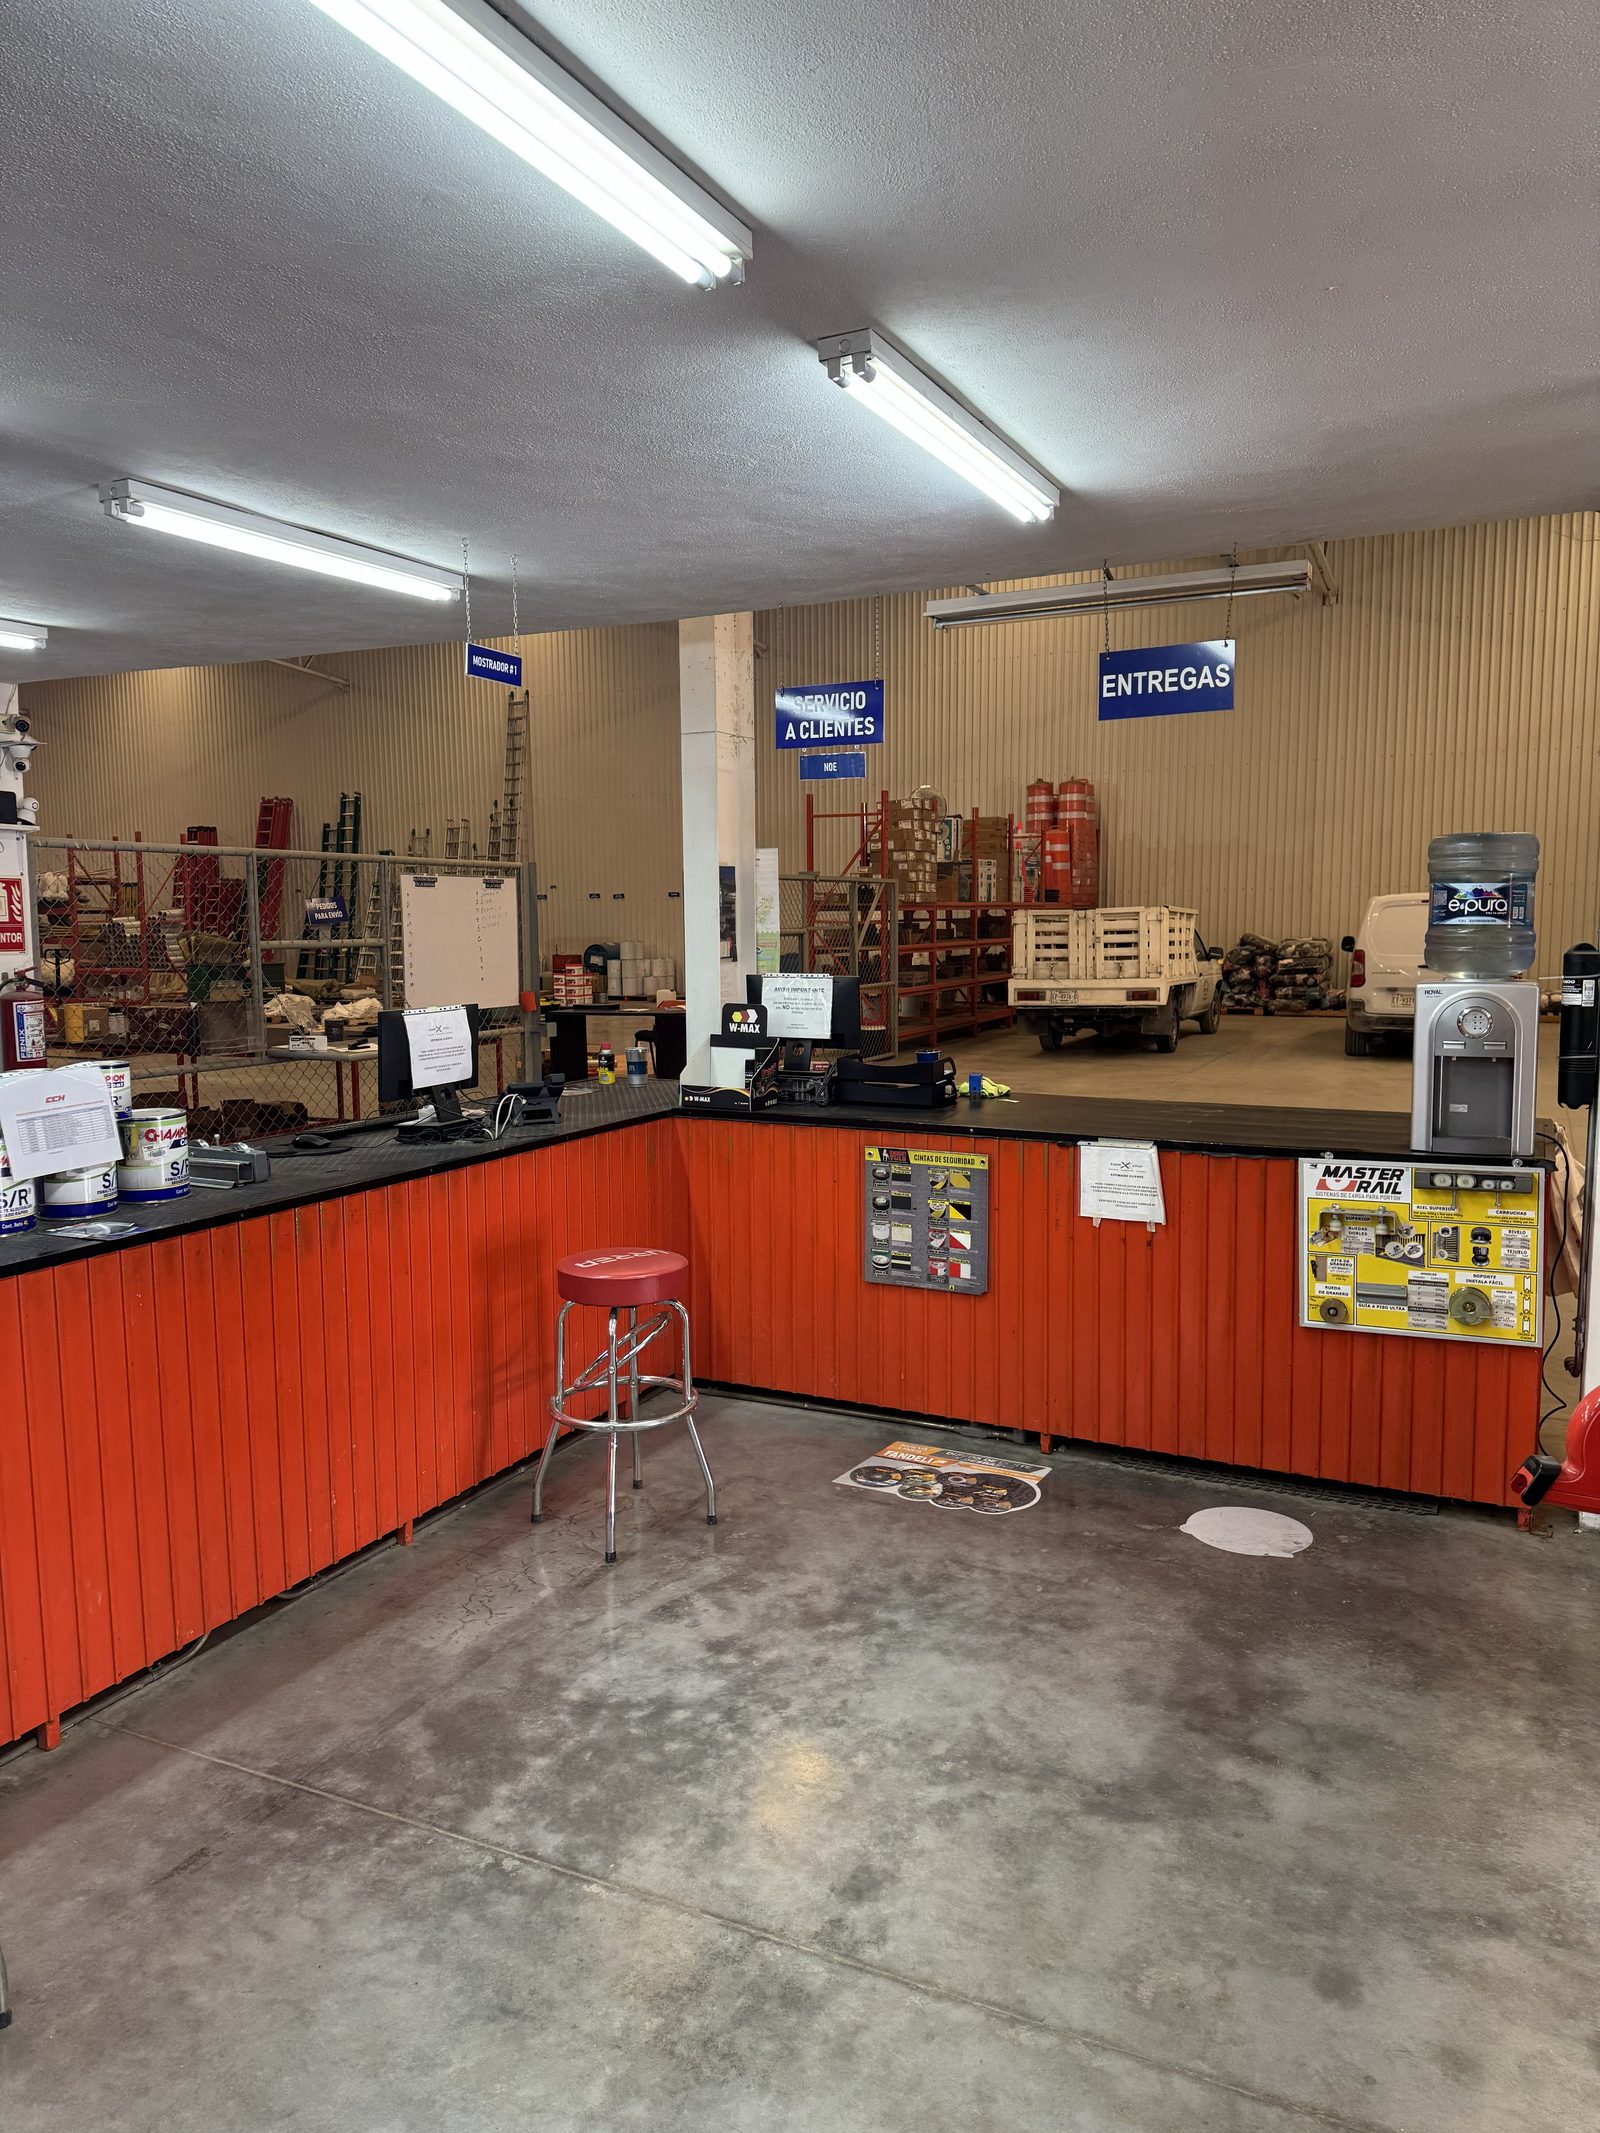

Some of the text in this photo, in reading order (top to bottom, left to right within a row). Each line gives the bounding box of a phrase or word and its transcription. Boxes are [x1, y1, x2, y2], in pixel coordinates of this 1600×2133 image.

[472, 655, 509, 673] MOSTRADOR
[1102, 663, 1230, 698] ENTREGAS
[794, 691, 866, 713] SERVICIO
[784, 717, 875, 740] A CLIENTES
[823, 762, 838, 772] NOE
[729, 1022, 760, 1034] W-MAX
[914, 1154, 933, 1162] CINTAS
[942, 1156, 976, 1166] SEGURIDAD
[1322, 1165, 1404, 1181] MASTER
[1356, 1180, 1403, 1195] RAIL
[884, 1450, 934, 1464] FANDELI
